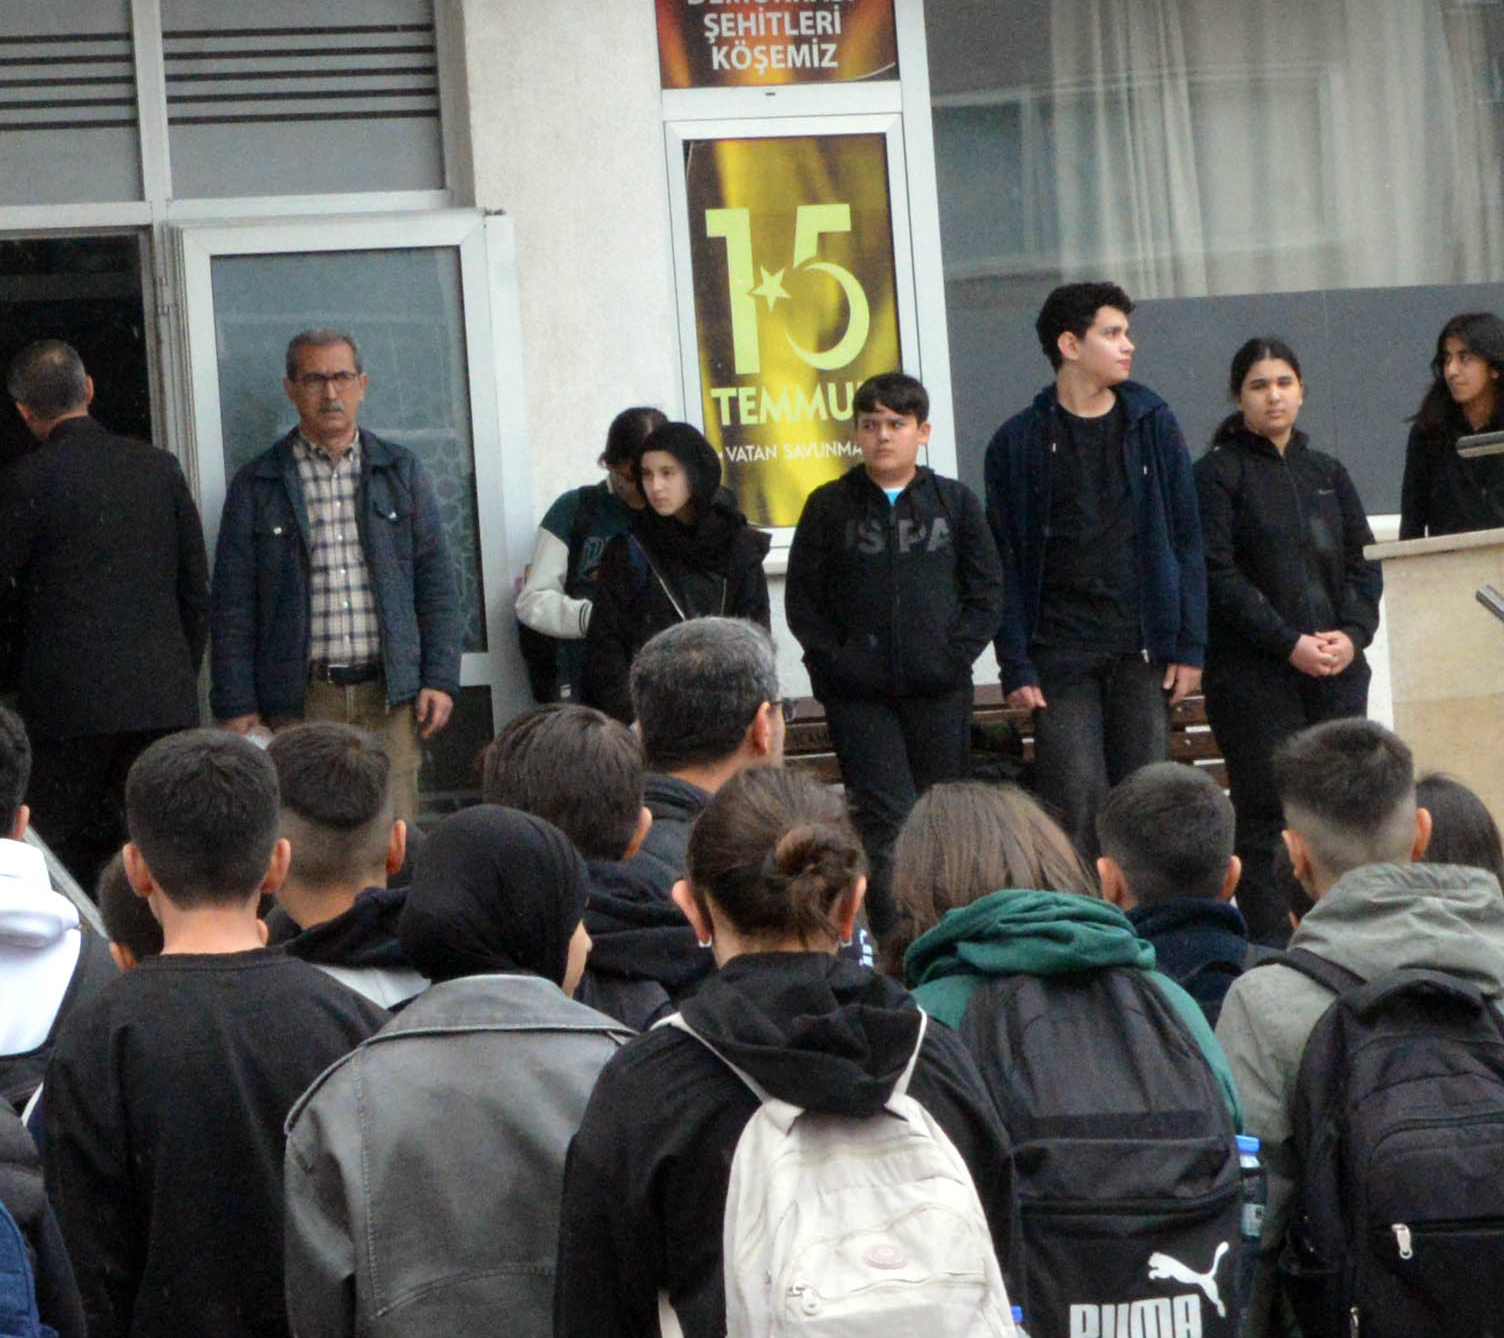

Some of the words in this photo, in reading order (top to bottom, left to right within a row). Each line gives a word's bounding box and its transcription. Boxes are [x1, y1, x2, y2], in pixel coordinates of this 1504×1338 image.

[703, 5, 842, 45] ŞEHİTLERİ
[711, 38, 840, 76] KÖŞEMİZ
[705, 203, 870, 375] 15
[710, 380, 864, 426] TEMMU
[725, 443, 779, 462] VATAN
